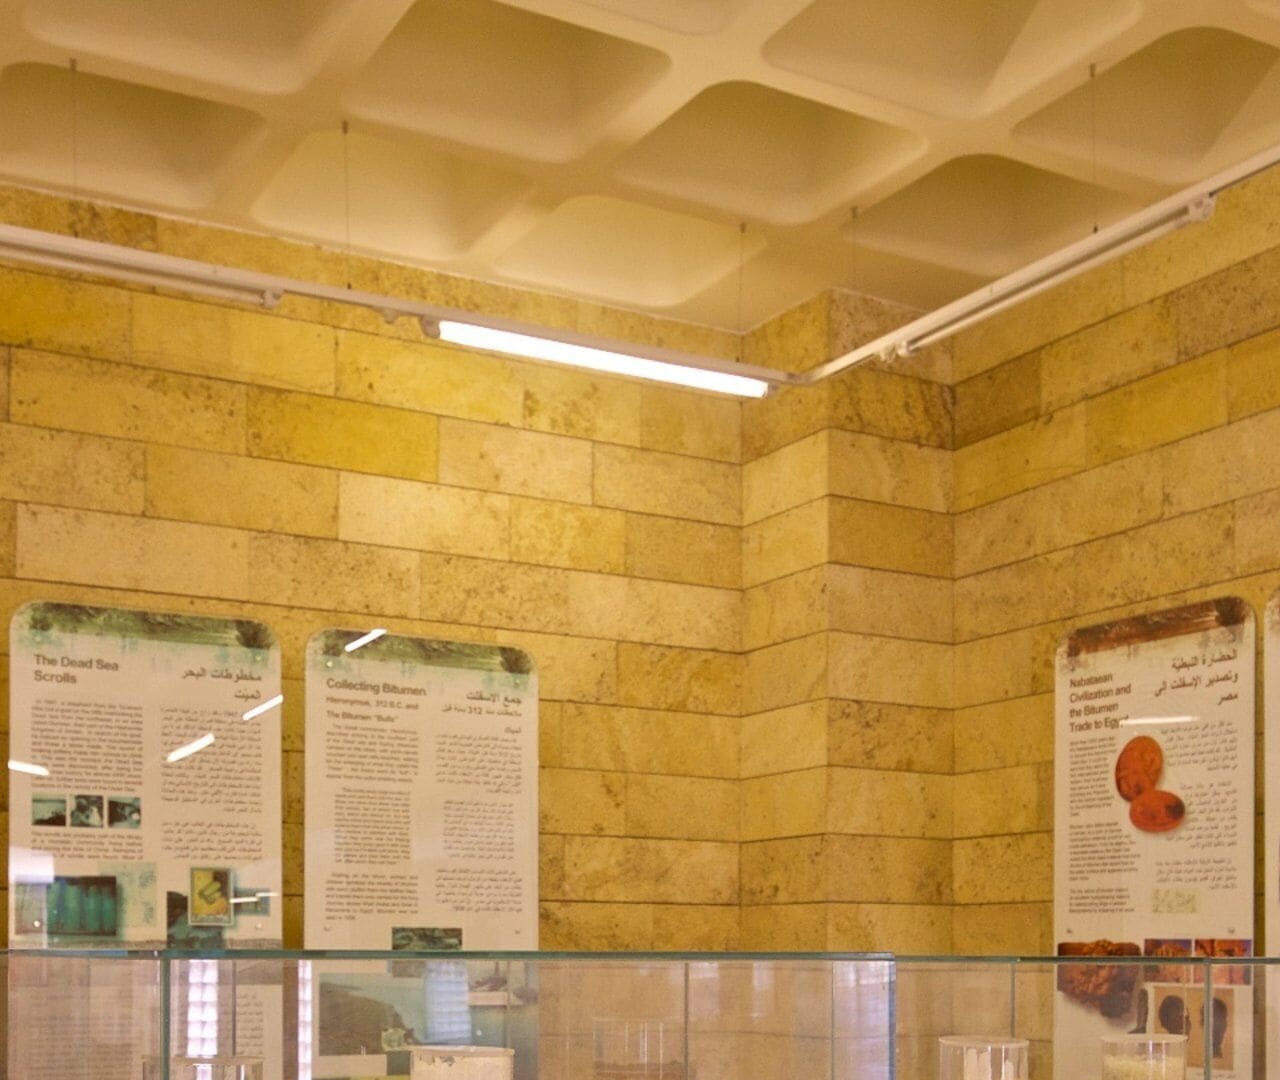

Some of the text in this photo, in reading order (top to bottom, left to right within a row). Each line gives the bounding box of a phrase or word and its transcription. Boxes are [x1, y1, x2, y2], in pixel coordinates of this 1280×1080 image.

[34, 654, 119, 671] The Dead Sea
[34, 670, 77, 683] Scrolls
[326, 678, 427, 696] Collecting Bitumen
[1070, 683, 1132, 703] Civilization and
[1070, 703, 1119, 718] the Bitumen
[1070, 721, 1093, 733] Trade
[1094, 720, 1104, 730] to
